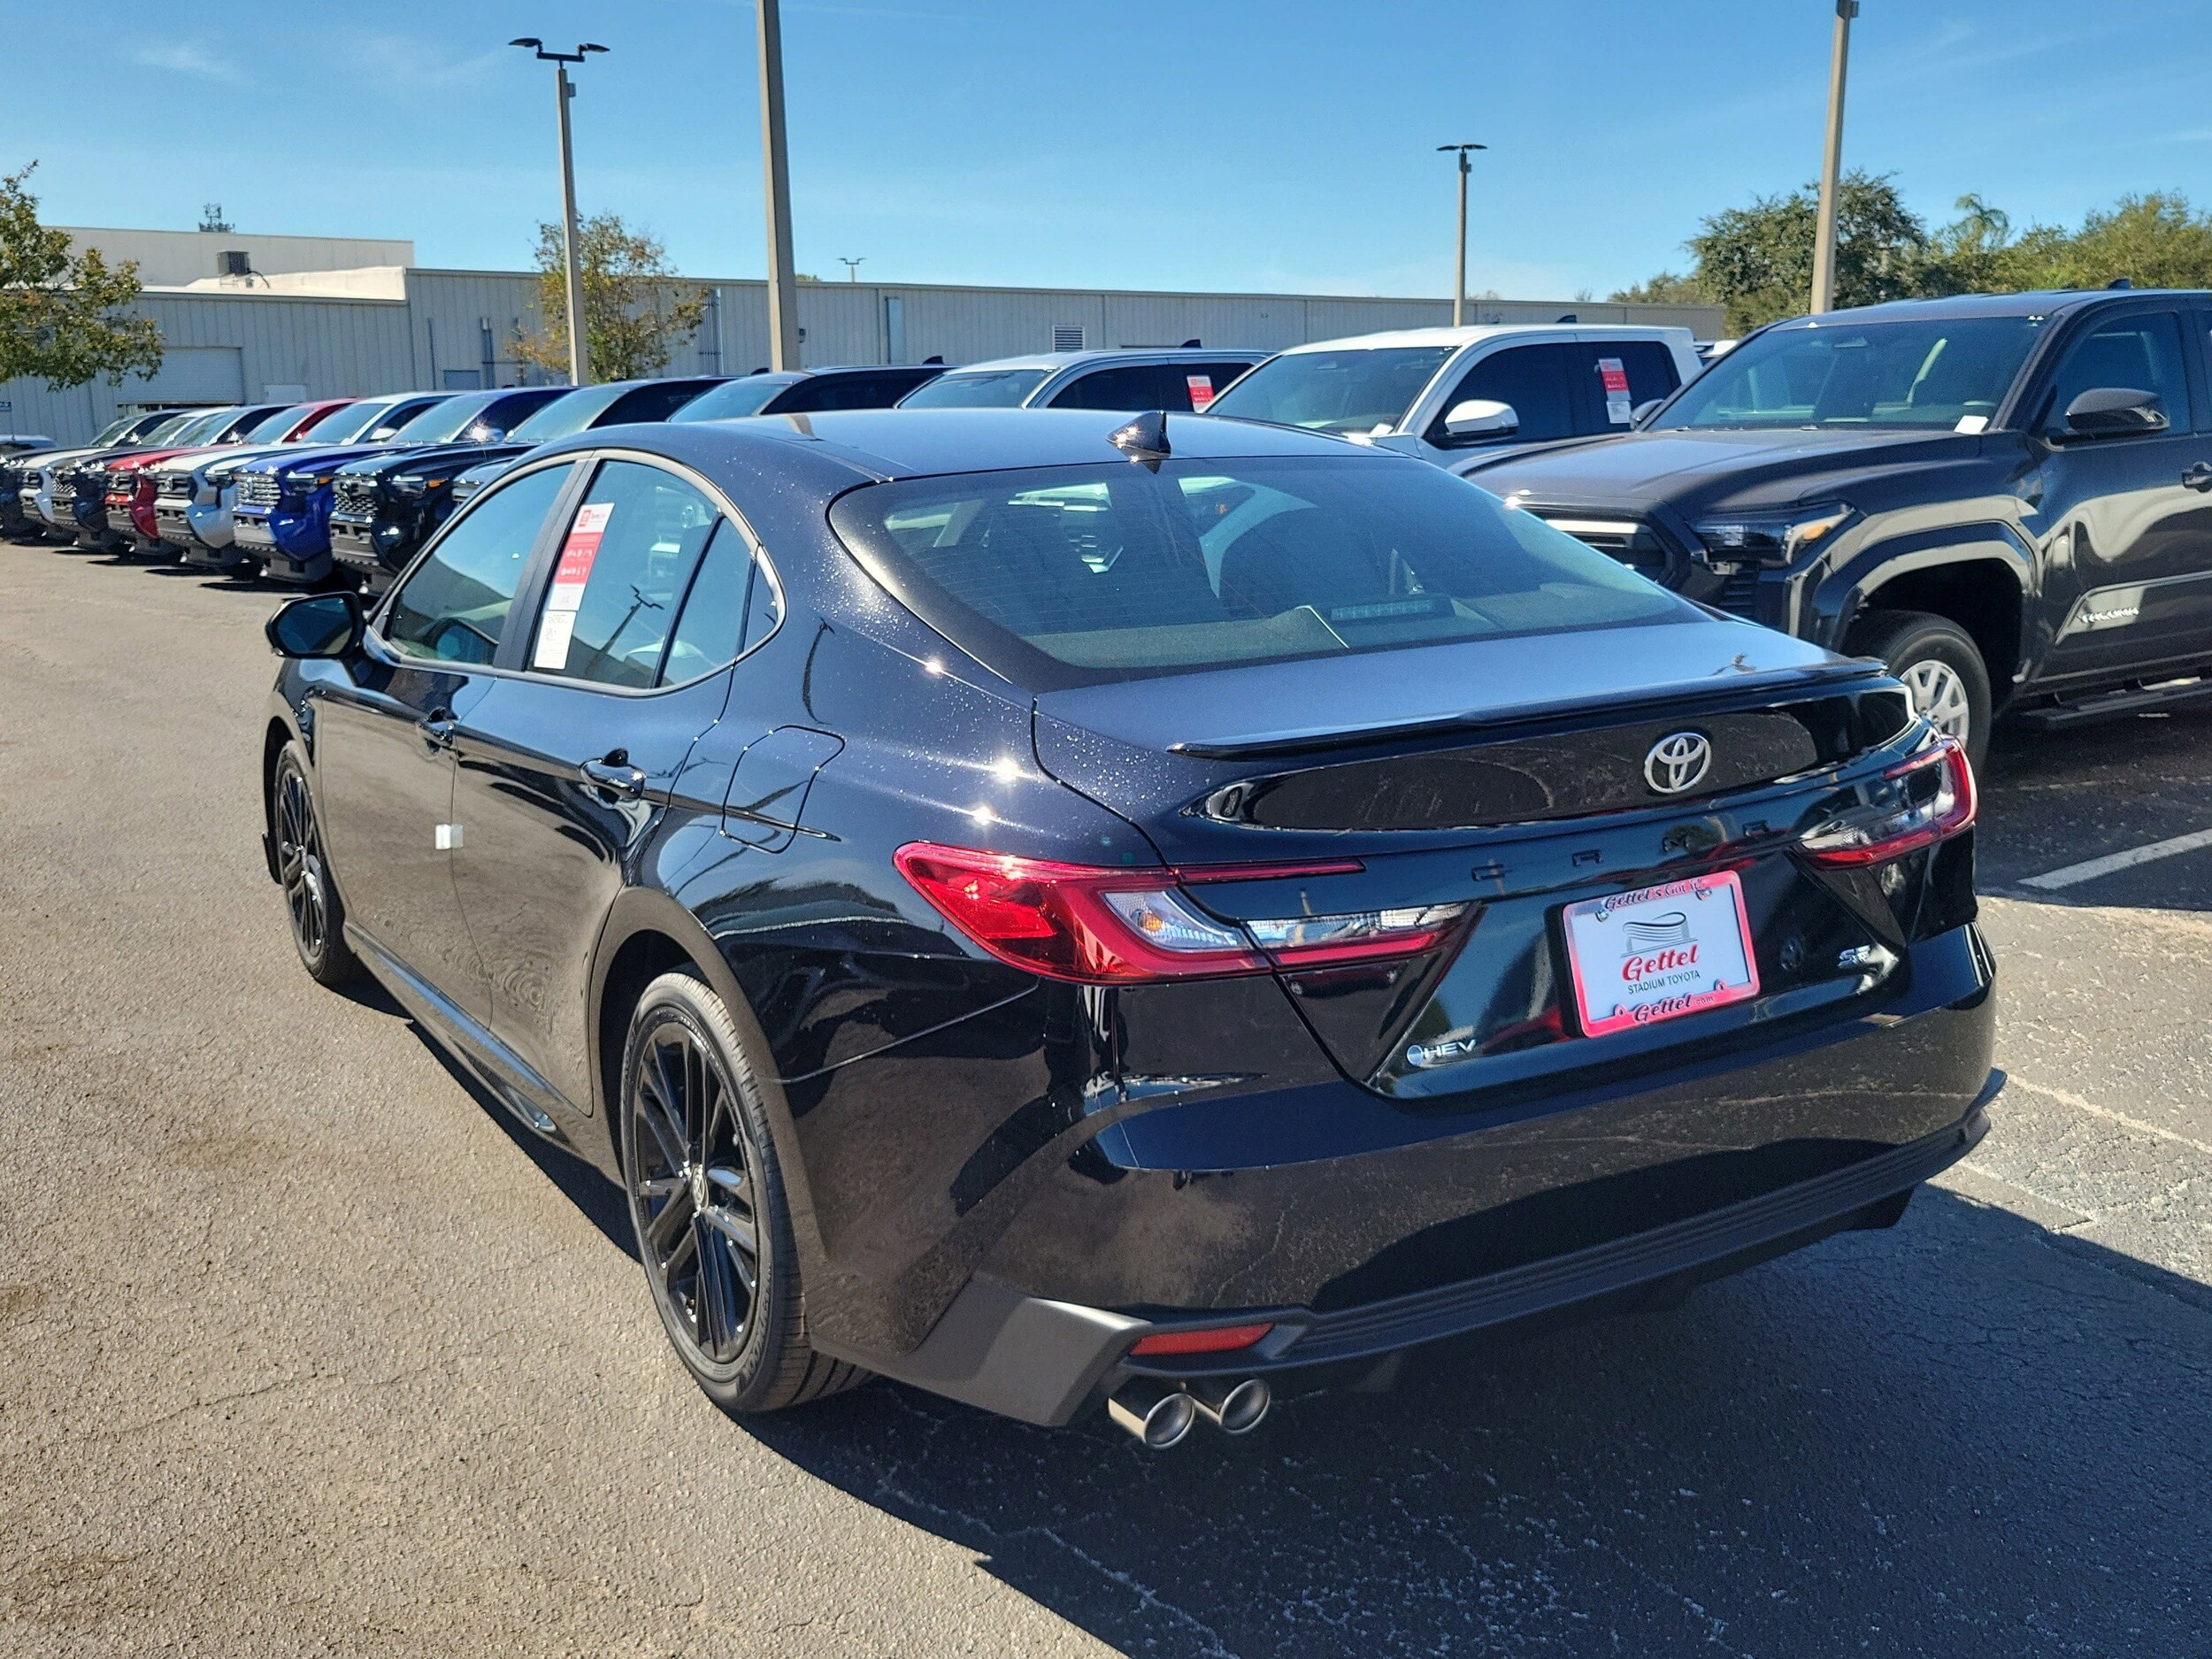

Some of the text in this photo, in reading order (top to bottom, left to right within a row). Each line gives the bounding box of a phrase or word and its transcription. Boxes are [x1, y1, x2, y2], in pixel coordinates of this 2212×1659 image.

[1603, 887, 1662, 912] Gettel's
[1622, 943, 1699, 982] Gettel
[1628, 970, 1701, 995] STADIUM TOYOTA
[1634, 994, 1693, 1023] Gettel
[1423, 1039, 1477, 1060] HEV
